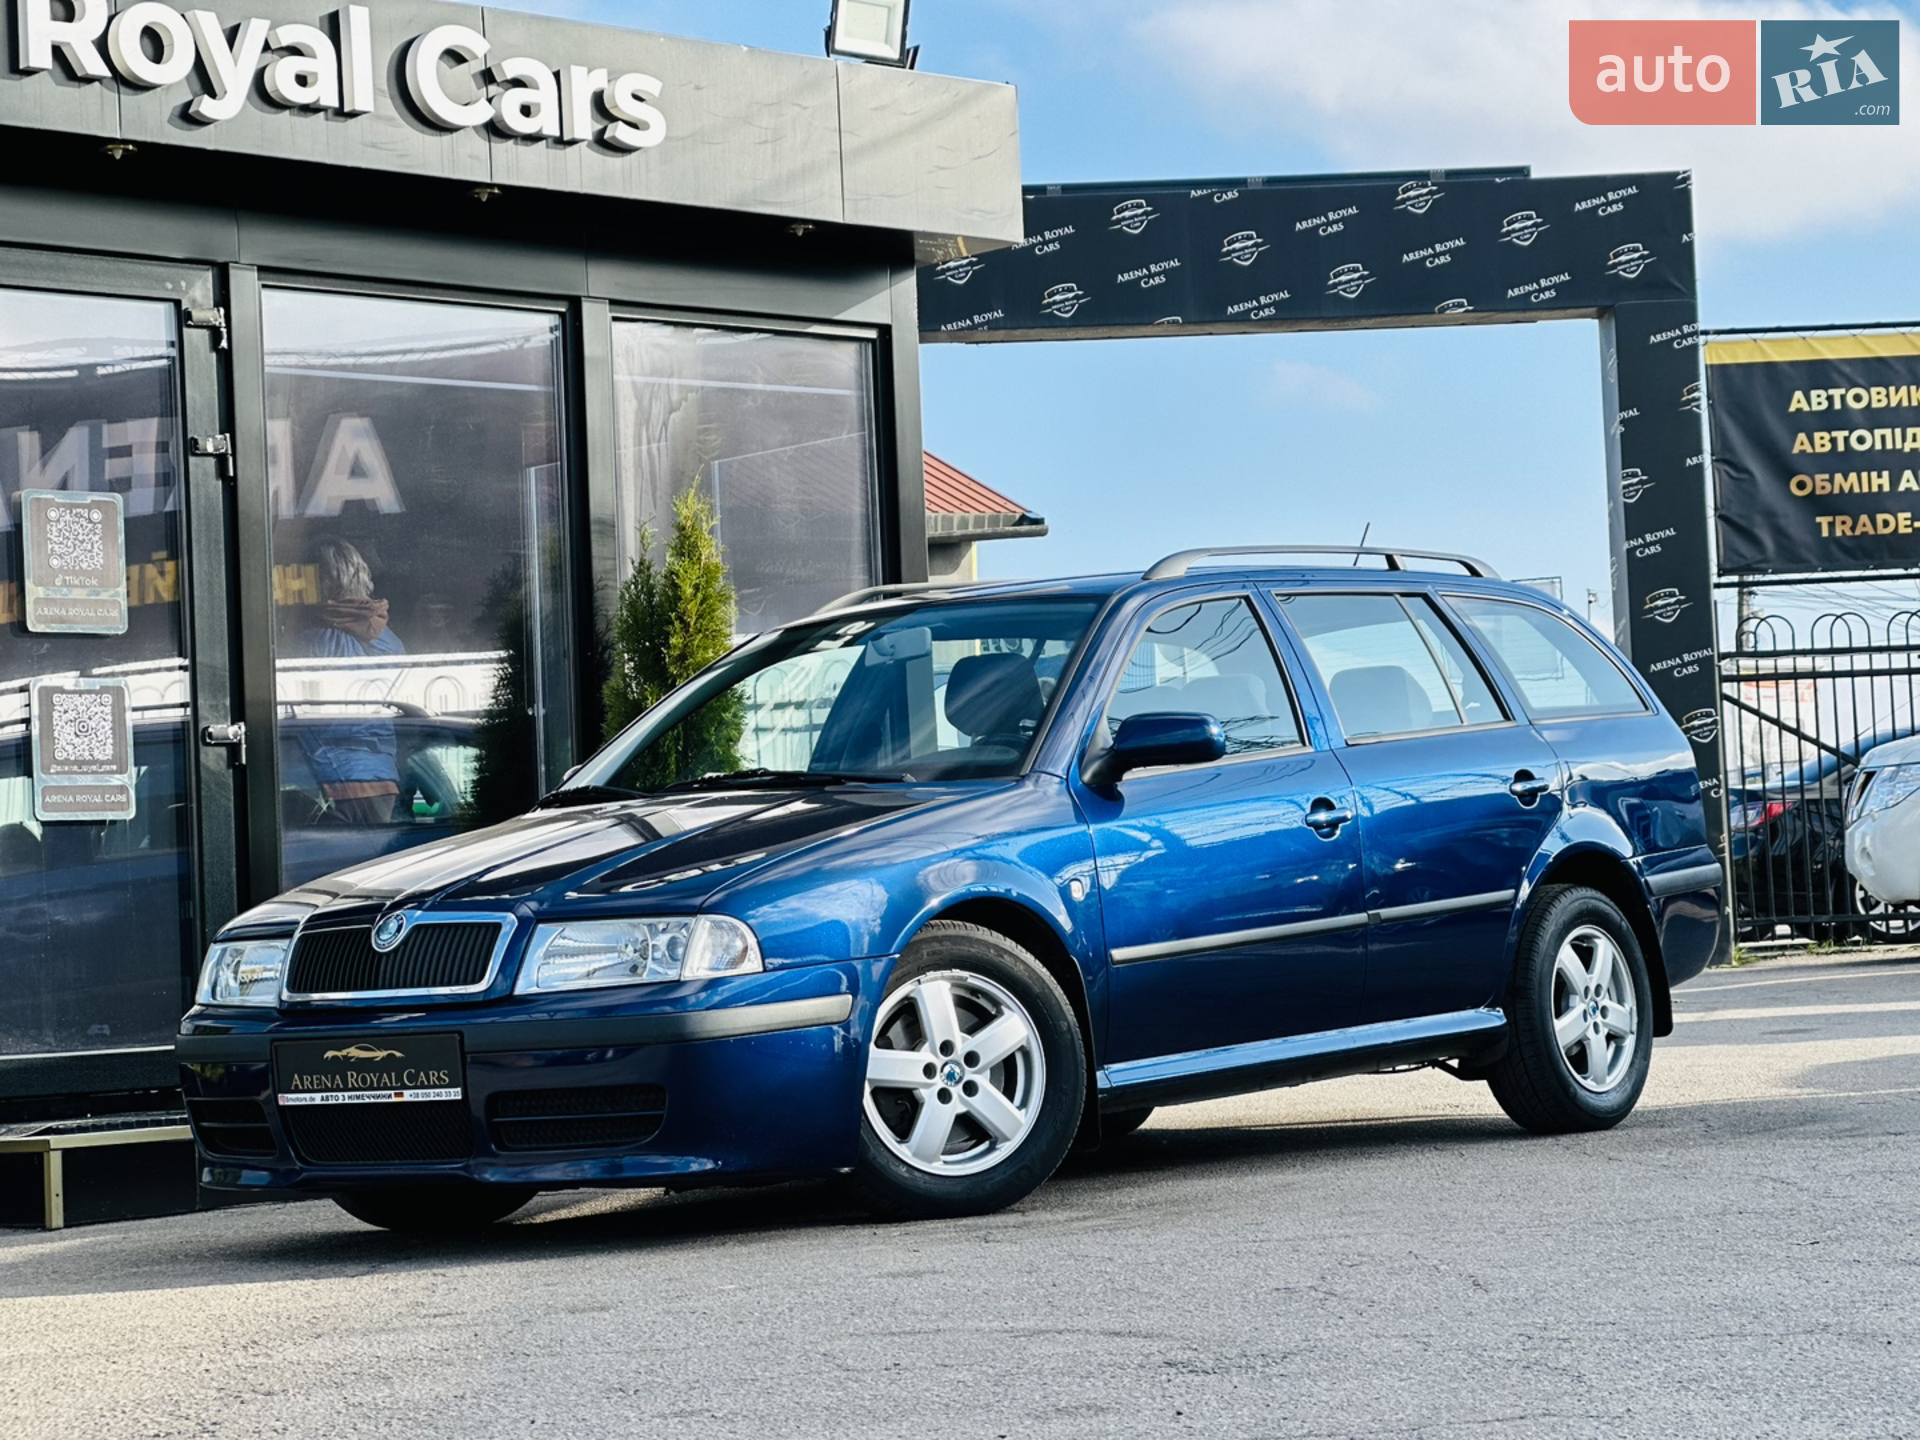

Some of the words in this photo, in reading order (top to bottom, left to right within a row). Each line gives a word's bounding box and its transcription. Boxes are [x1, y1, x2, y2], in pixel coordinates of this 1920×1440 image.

[17, 0, 376, 123] Royal
[405, 23, 668, 150] Cars
[1213, 188, 1239, 203] CARS
[1574, 195, 1607, 212] ARENA
[1607, 185, 1640, 201] ROYAL
[1598, 201, 1624, 216] CARS
[1295, 215, 1327, 232] ARENA
[1327, 205, 1359, 221] ROYAL
[1044, 224, 1076, 240] ROYAL
[1318, 221, 1344, 236] CARS
[1035, 241, 1061, 255] CARS
[1401, 247, 1434, 263] ARENA
[1434, 237, 1467, 253] ROYAL
[1425, 253, 1451, 268] CARS
[1116, 267, 1149, 283] ARENA
[1149, 258, 1182, 273] ROYAL
[1140, 274, 1166, 288] CARS
[1507, 282, 1539, 298] ARENA
[1539, 272, 1572, 288] ROYAL
[1227, 299, 1259, 315] ARENA
[1259, 289, 1291, 305] ROYAL
[1530, 288, 1557, 302] CARS
[1250, 306, 1276, 320] CARS
[1649, 328, 1681, 345] ARENA
[1673, 335, 1700, 349] CARS
[1616, 407, 1641, 421] OYAL
[1789, 469, 1890, 497] ОБМІН
[1815, 511, 1920, 538] TRADE-
[1645, 527, 1677, 543] ROYAL
[1635, 543, 1662, 557] CARS
[64, 575, 99, 586] TikTok
[1650, 657, 1682, 673] ARENA
[1682, 647, 1715, 663] ROYAL
[1673, 663, 1700, 677] CARS
[44, 794, 74, 803] ARENA
[75, 794, 101, 803] ROYAL
[104, 793, 127, 802] CARS
[291, 1073, 344, 1090] ARENA
[346, 1070, 401, 1089] ROYAL
[403, 1068, 450, 1087] CARS
[320, 1094, 340, 1102] АВТО
